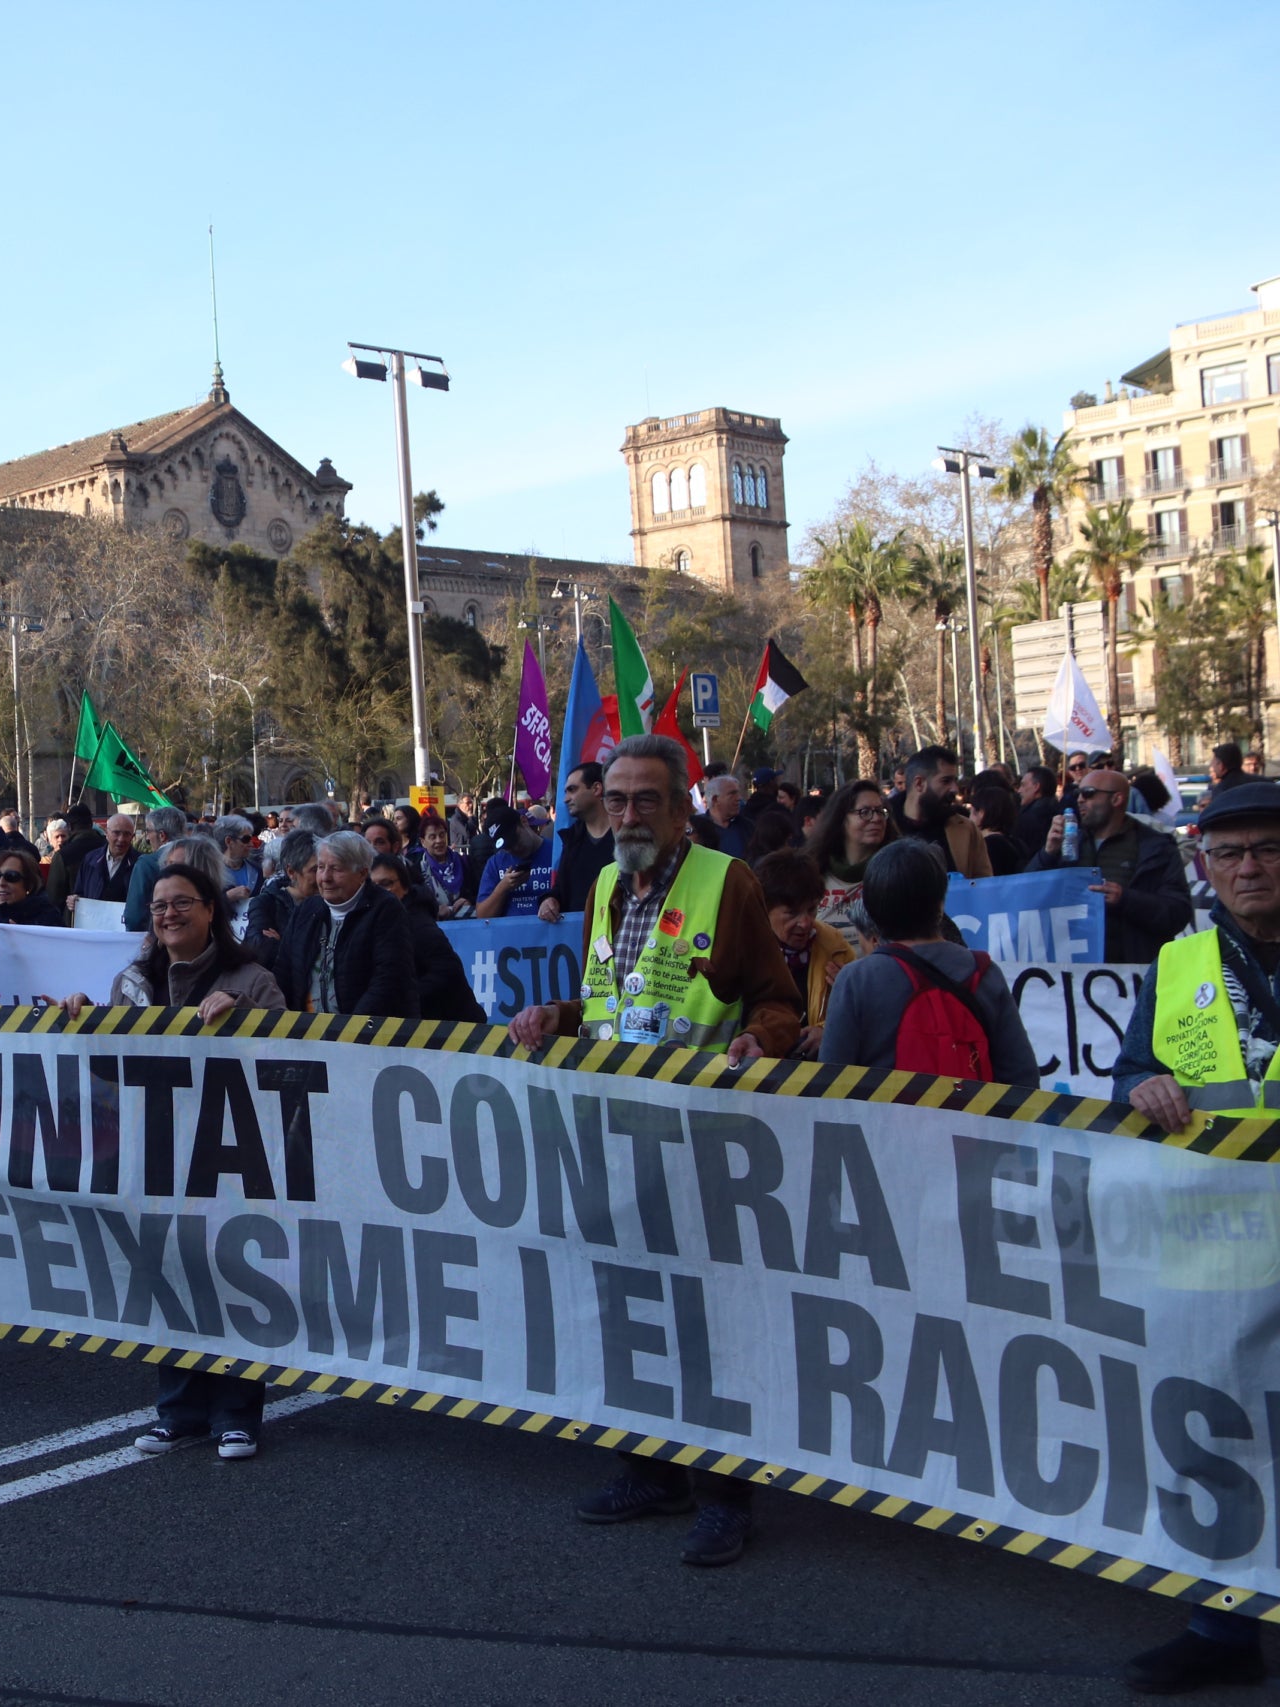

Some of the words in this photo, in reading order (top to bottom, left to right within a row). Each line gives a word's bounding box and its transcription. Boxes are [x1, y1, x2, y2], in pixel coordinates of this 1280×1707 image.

[696, 677, 713, 711] P
[652, 969, 662, 977] no
[1178, 1015, 1193, 1029] NO
[371, 1064, 912, 1293] CONTRA
[951, 1134, 1148, 1348] EL
[518, 1246, 557, 1395] I
[593, 1261, 753, 1438] EL
